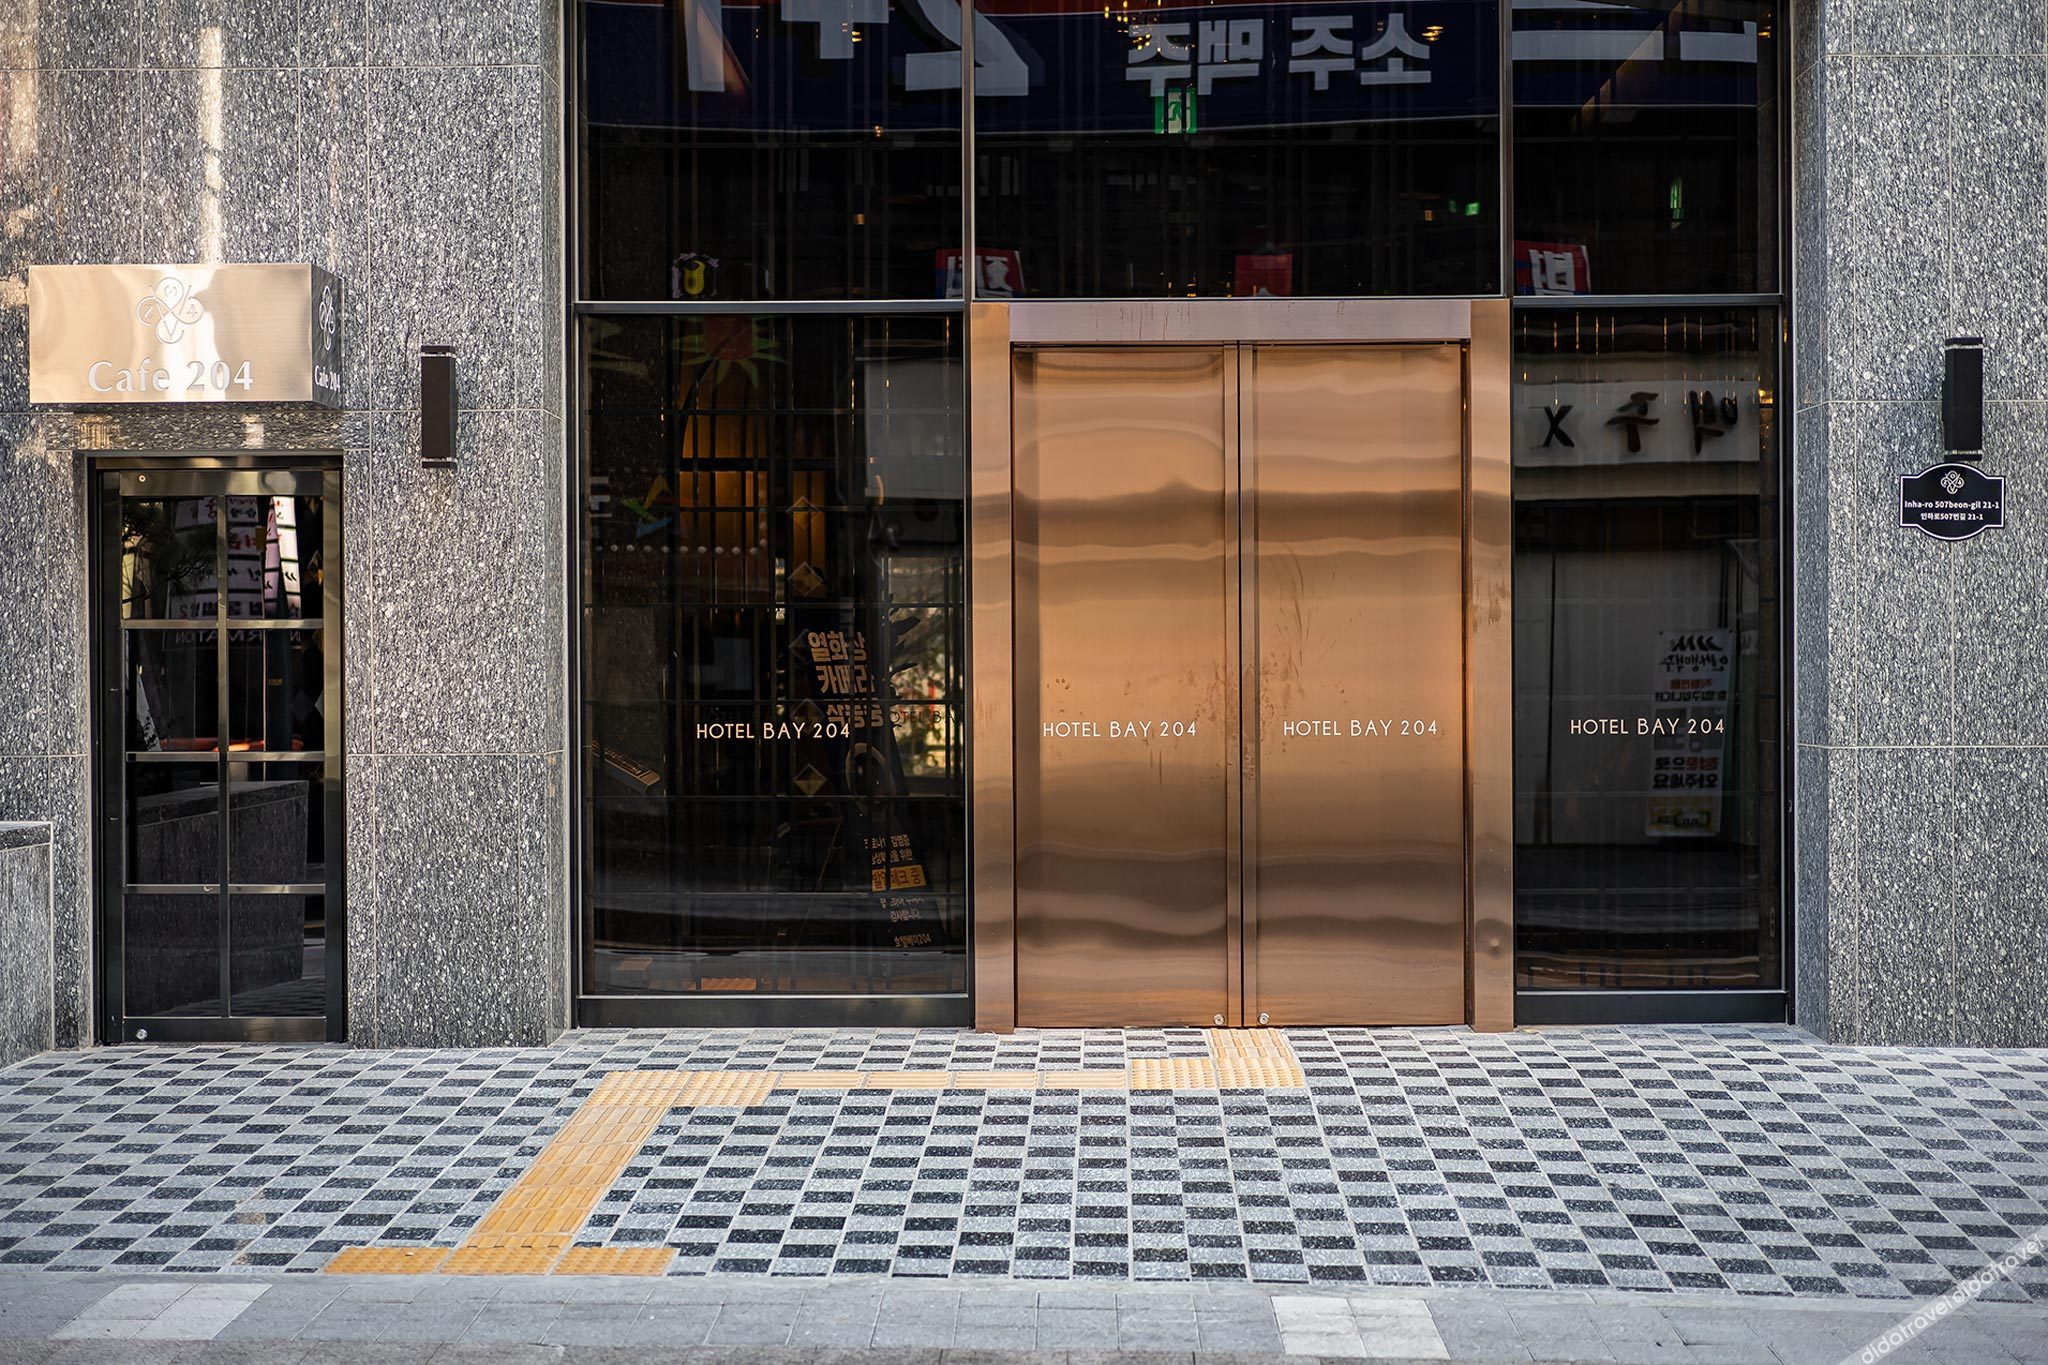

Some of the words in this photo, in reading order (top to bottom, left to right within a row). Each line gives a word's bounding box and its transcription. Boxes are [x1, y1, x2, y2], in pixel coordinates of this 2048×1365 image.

[87, 357, 169, 393] Cafe
[187, 359, 254, 392] 204
[314, 364, 328, 387] Cafe
[328, 370, 341, 394] 204
[1904, 500, 1933, 509] Inha-ro
[1935, 500, 1981, 510] 507beon-gil
[1982, 501, 2000, 509] 21-1
[1920, 512, 1966, 521] 인하로507번길
[1967, 513, 1984, 521] 21-1
[807, 630, 868, 663] 열화상
[696, 723, 755, 739] HOTEL
[763, 722, 806, 739] BAY
[812, 722, 850, 739] 204
[1043, 722, 1101, 737] HOTEL
[1110, 721, 1152, 737] BAY
[1160, 721, 1197, 737] 204
[1284, 721, 1341, 736] HOTEL
[1350, 720, 1392, 736] BAY
[1400, 720, 1437, 736] 204
[1570, 719, 1628, 735] HOTEL
[1637, 718, 1680, 735] BAY
[1688, 718, 1725, 734] 204
